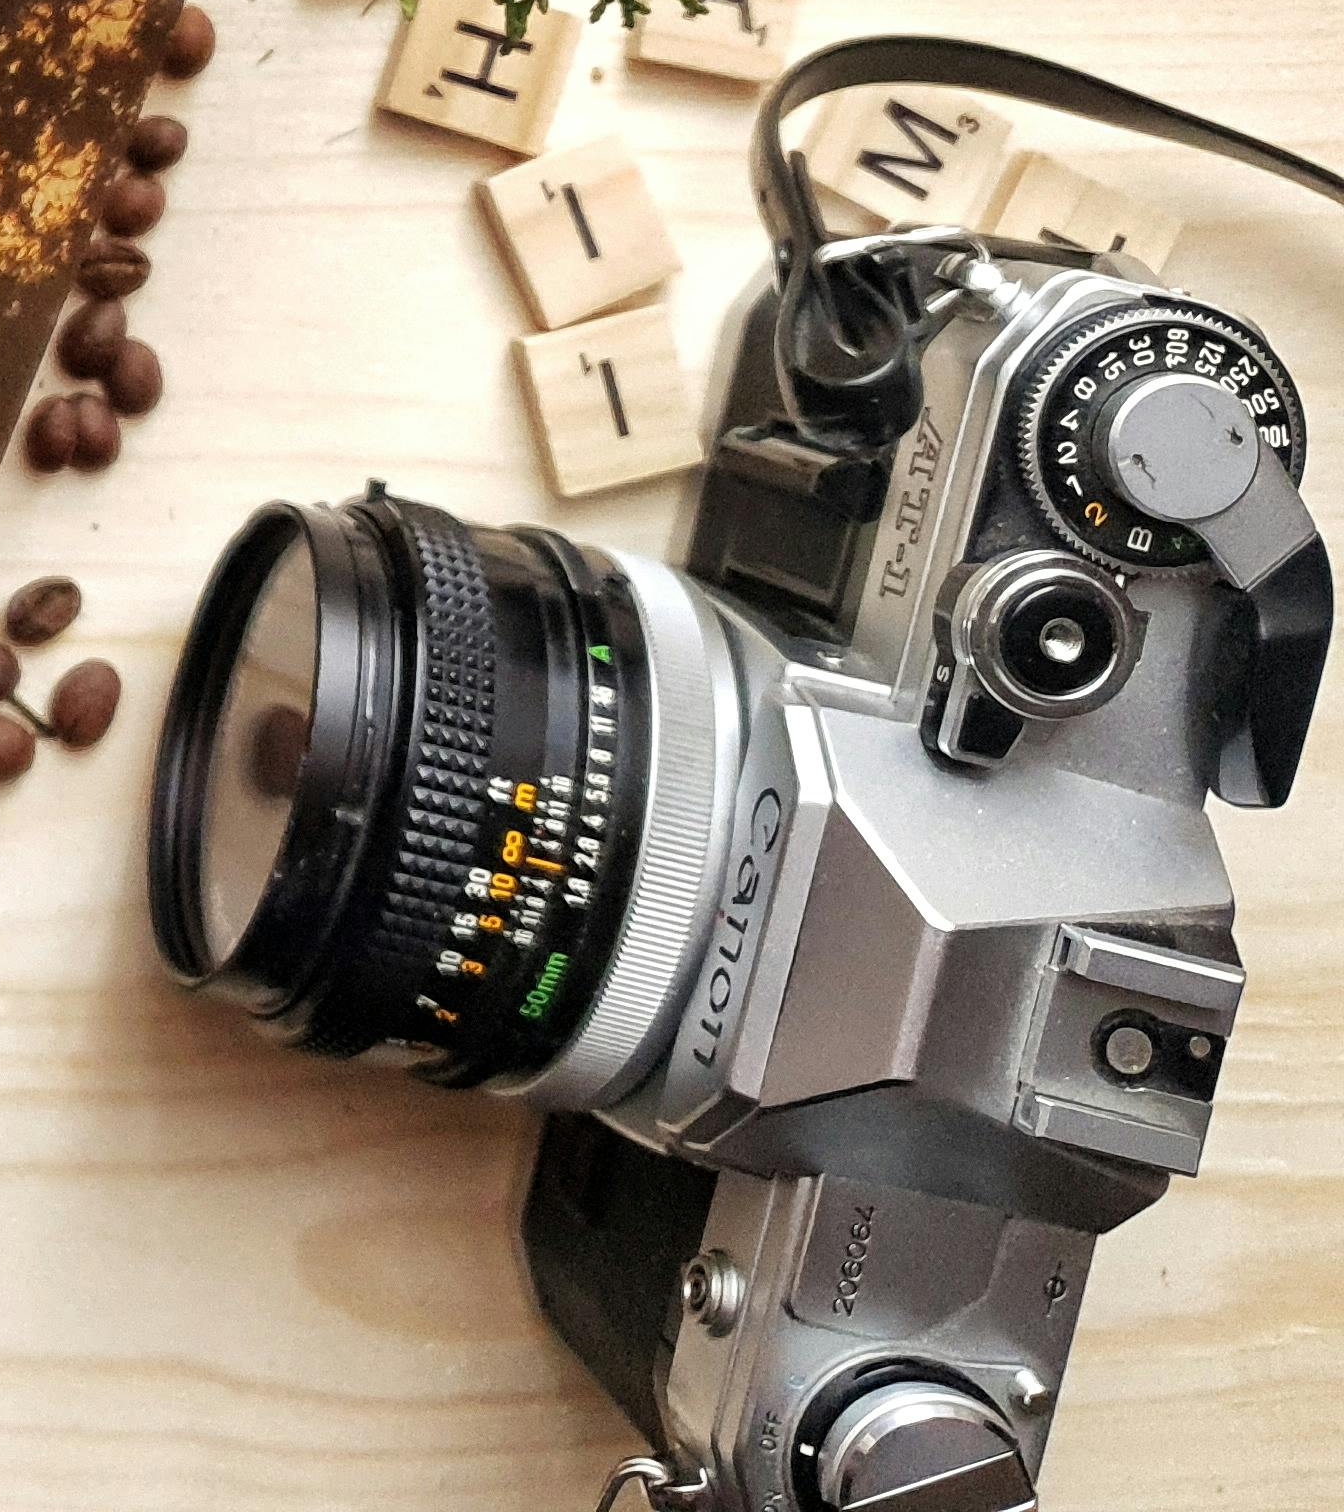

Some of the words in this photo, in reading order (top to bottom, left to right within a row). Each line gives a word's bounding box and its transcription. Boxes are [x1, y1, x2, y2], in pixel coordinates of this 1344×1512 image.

[440, 20, 534, 102] H
[856, 98, 961, 201] M
[1128, 335, 1155, 367] 30
[1194, 341, 1226, 376] 125
[1098, 352, 1127, 380] 15
[1219, 356, 1259, 394] 250
[1073, 377, 1097, 400] 8
[1059, 409, 1079, 431] 4
[1057, 441, 1078, 465] 2
[1066, 474, 1084, 497] 1
[879, 406, 944, 598] AT-1
[1084, 501, 1109, 527] 2
[1127, 526, 1152, 553] B
[936, 664, 950, 682] S
[489, 873, 517, 901] 10
[692, 787, 783, 1069] Canon
